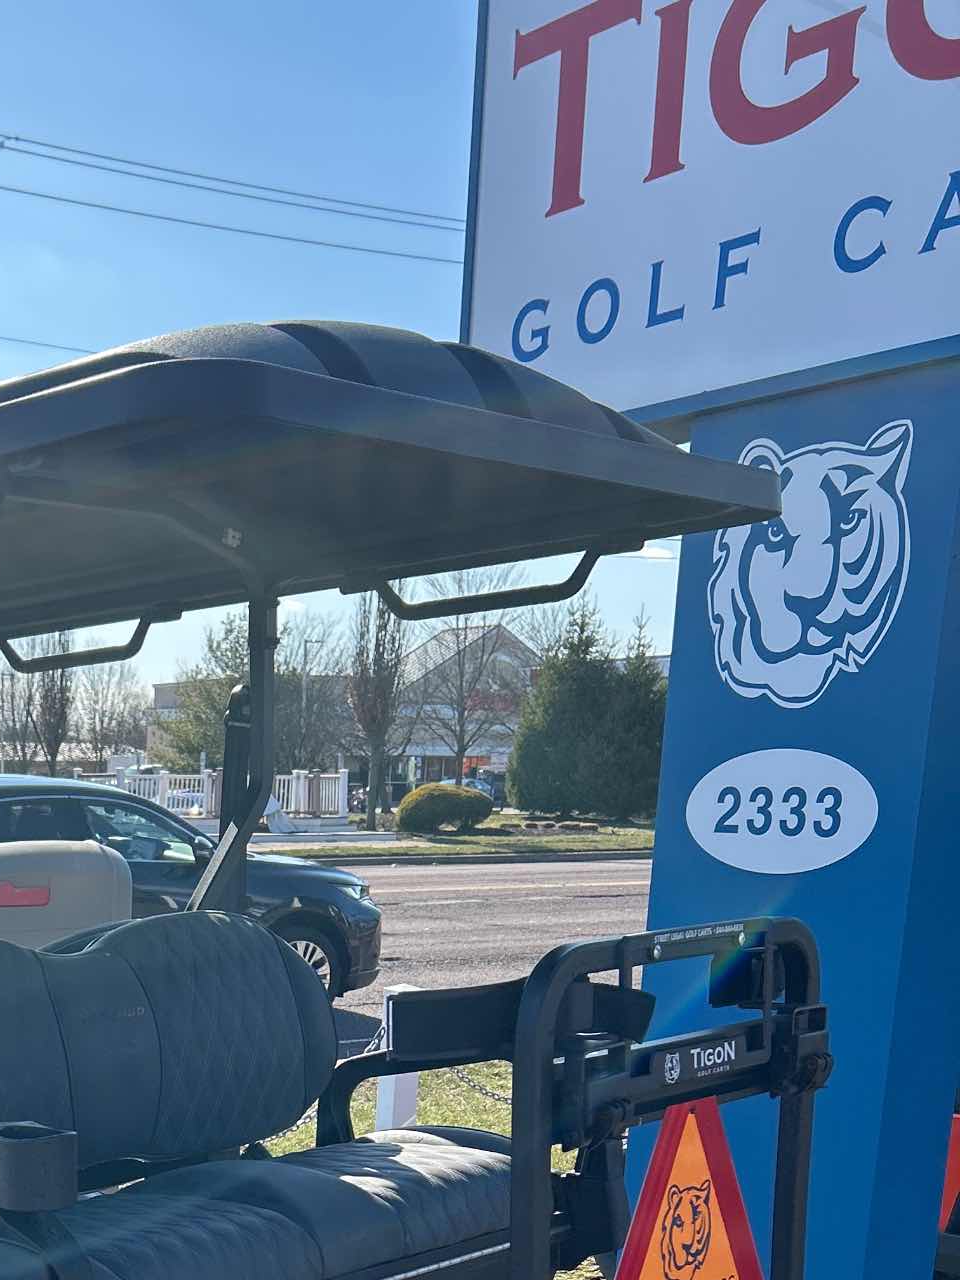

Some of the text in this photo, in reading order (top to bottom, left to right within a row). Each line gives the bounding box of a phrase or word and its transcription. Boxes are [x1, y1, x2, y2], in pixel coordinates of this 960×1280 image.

[511, 227, 762, 363] GOLF
[713, 786, 843, 838] 2333
[690, 1040, 735, 1069] TIGON
